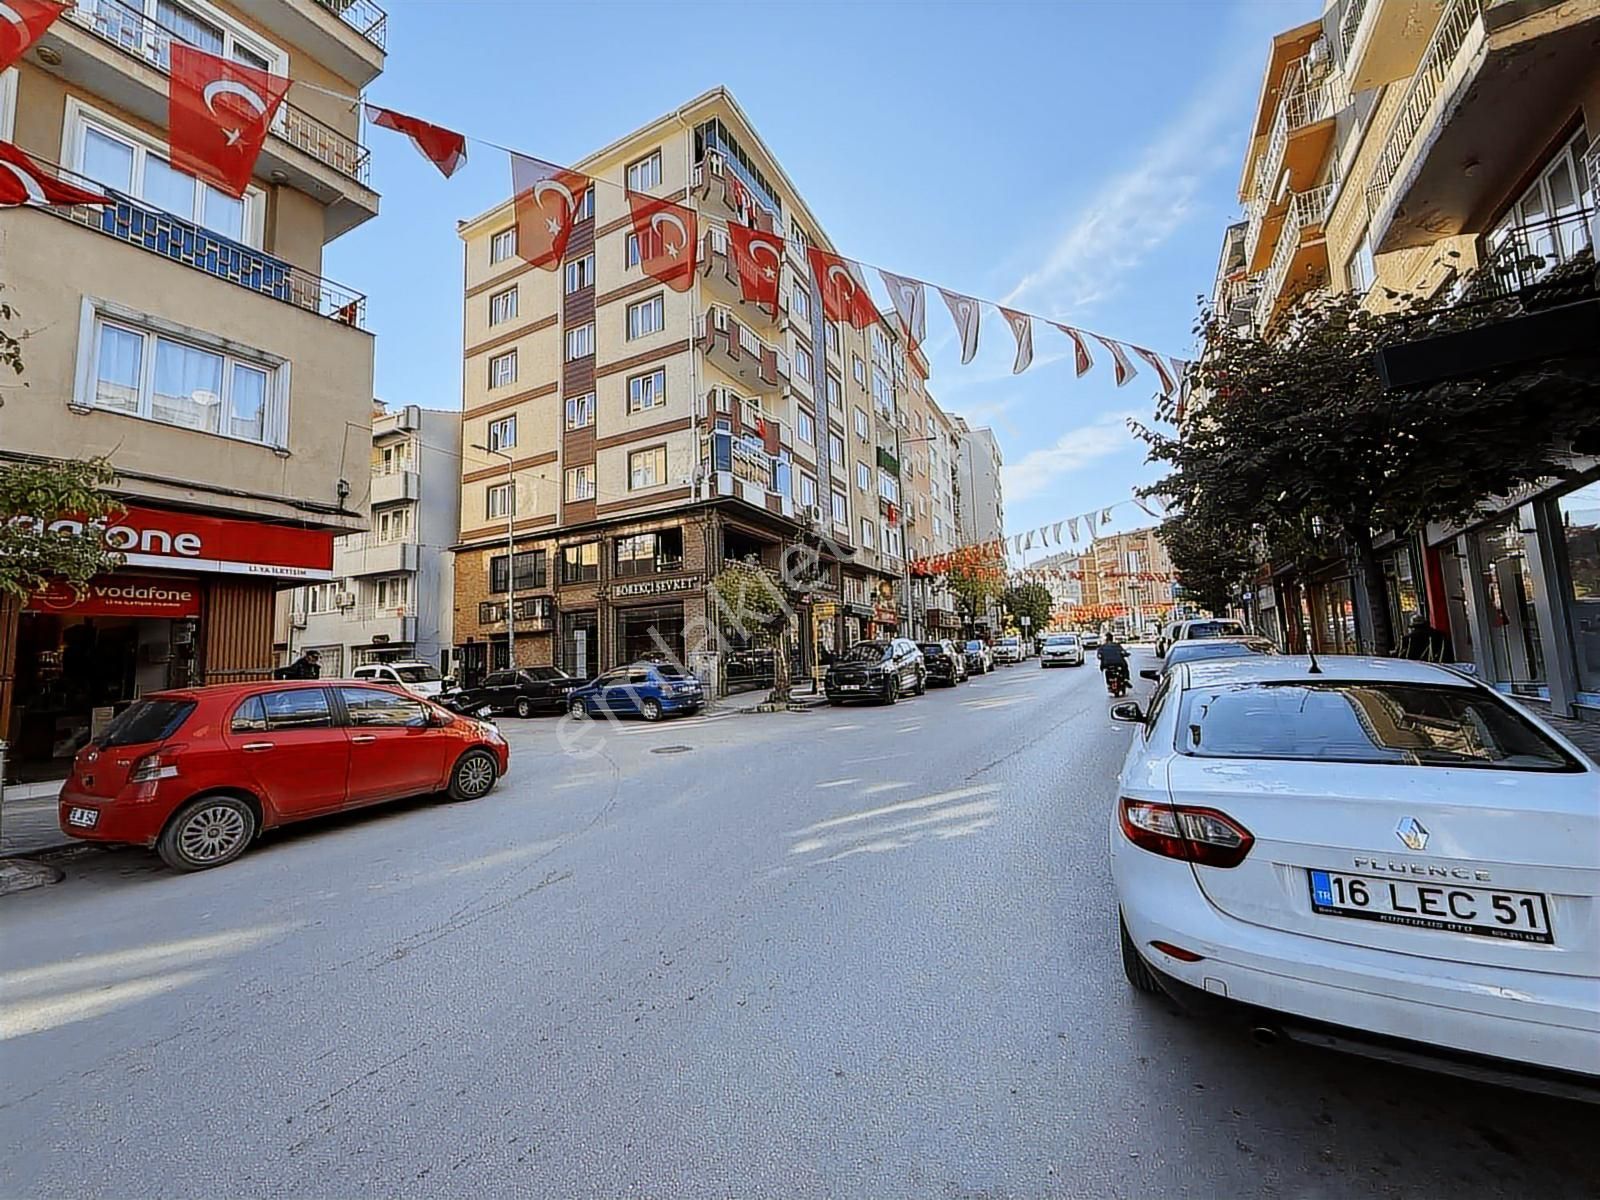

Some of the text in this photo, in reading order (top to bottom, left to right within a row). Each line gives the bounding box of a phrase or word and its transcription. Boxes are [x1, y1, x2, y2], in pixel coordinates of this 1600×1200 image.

[94, 584, 193, 601] vodafone
[1353, 856, 1492, 882] FLUENCE
[1317, 890, 1332, 901] TR
[1332, 877, 1538, 929] 16 LEC 51
